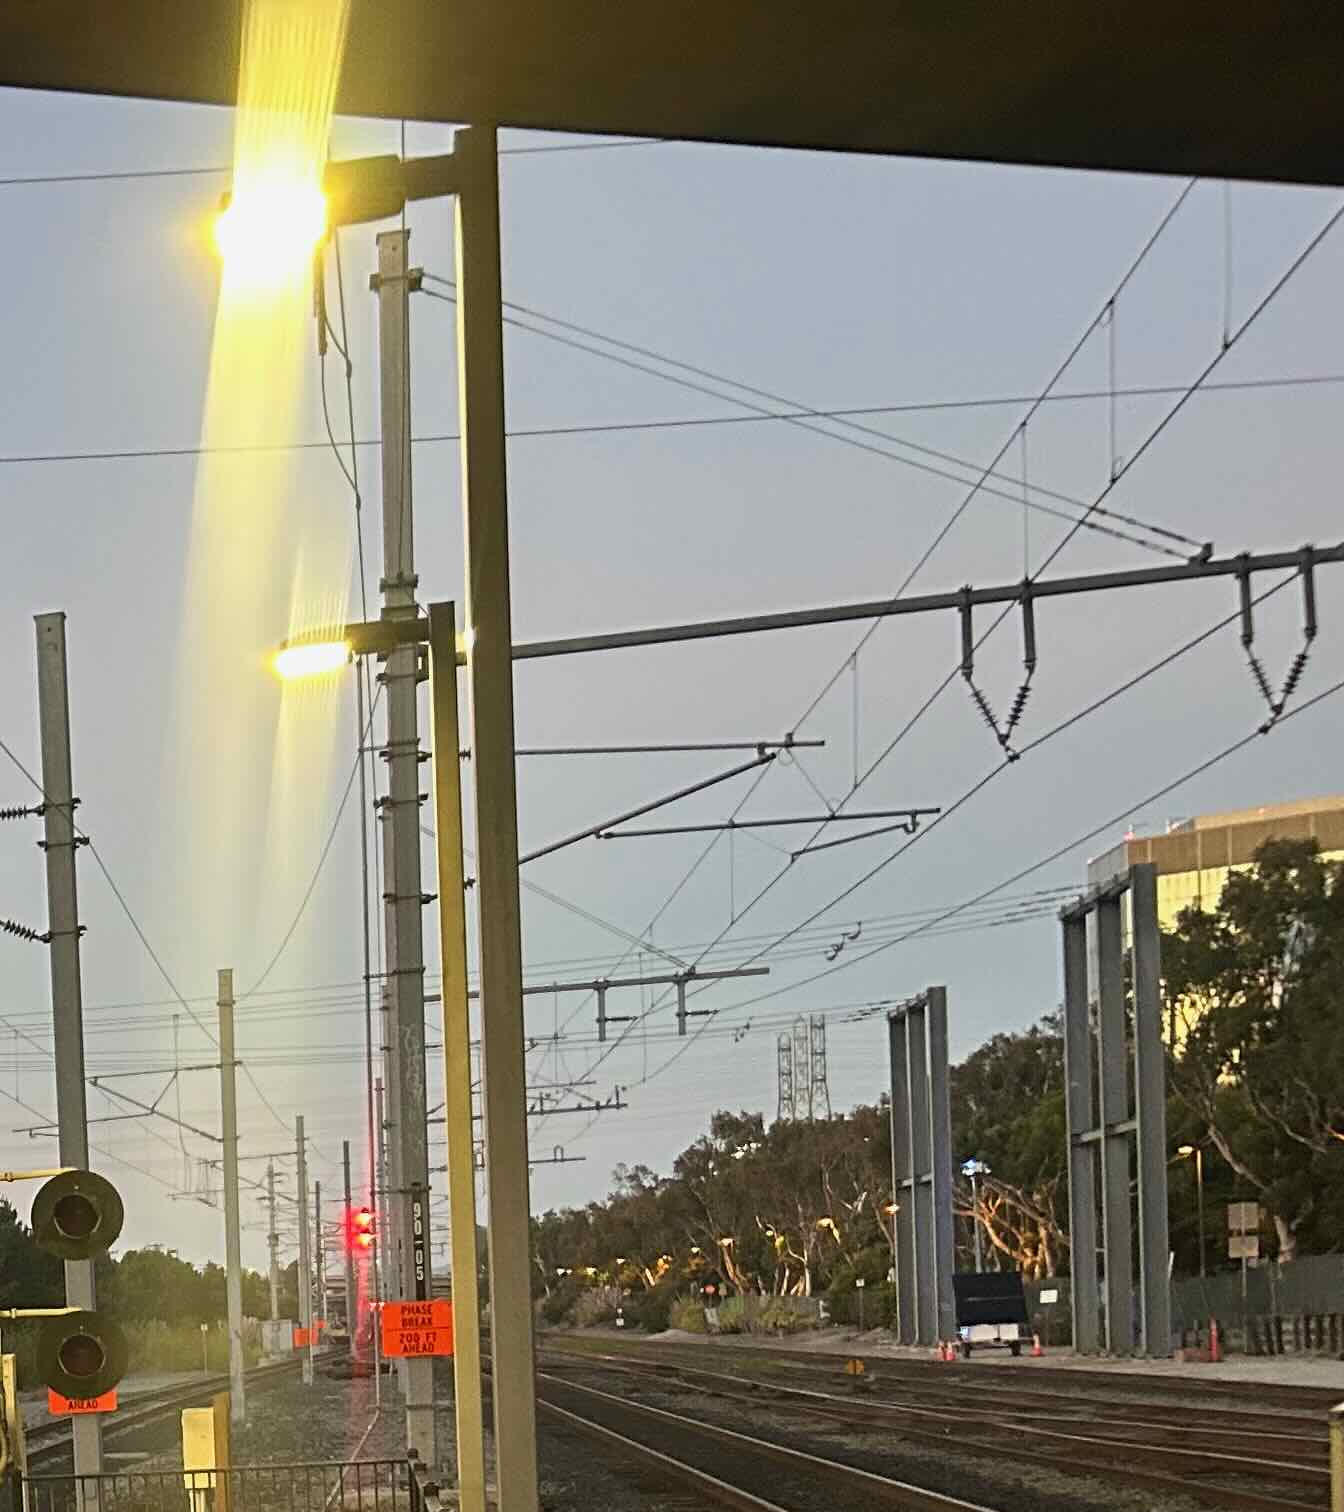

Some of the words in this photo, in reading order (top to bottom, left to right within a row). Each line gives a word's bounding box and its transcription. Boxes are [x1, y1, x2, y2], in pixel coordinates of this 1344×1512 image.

[401, 1303, 433, 1315] PHASE
[401, 1316, 433, 1329] BREAK
[402, 1343, 435, 1354] AHEAD
[67, 1398, 98, 1410] AHEAD
